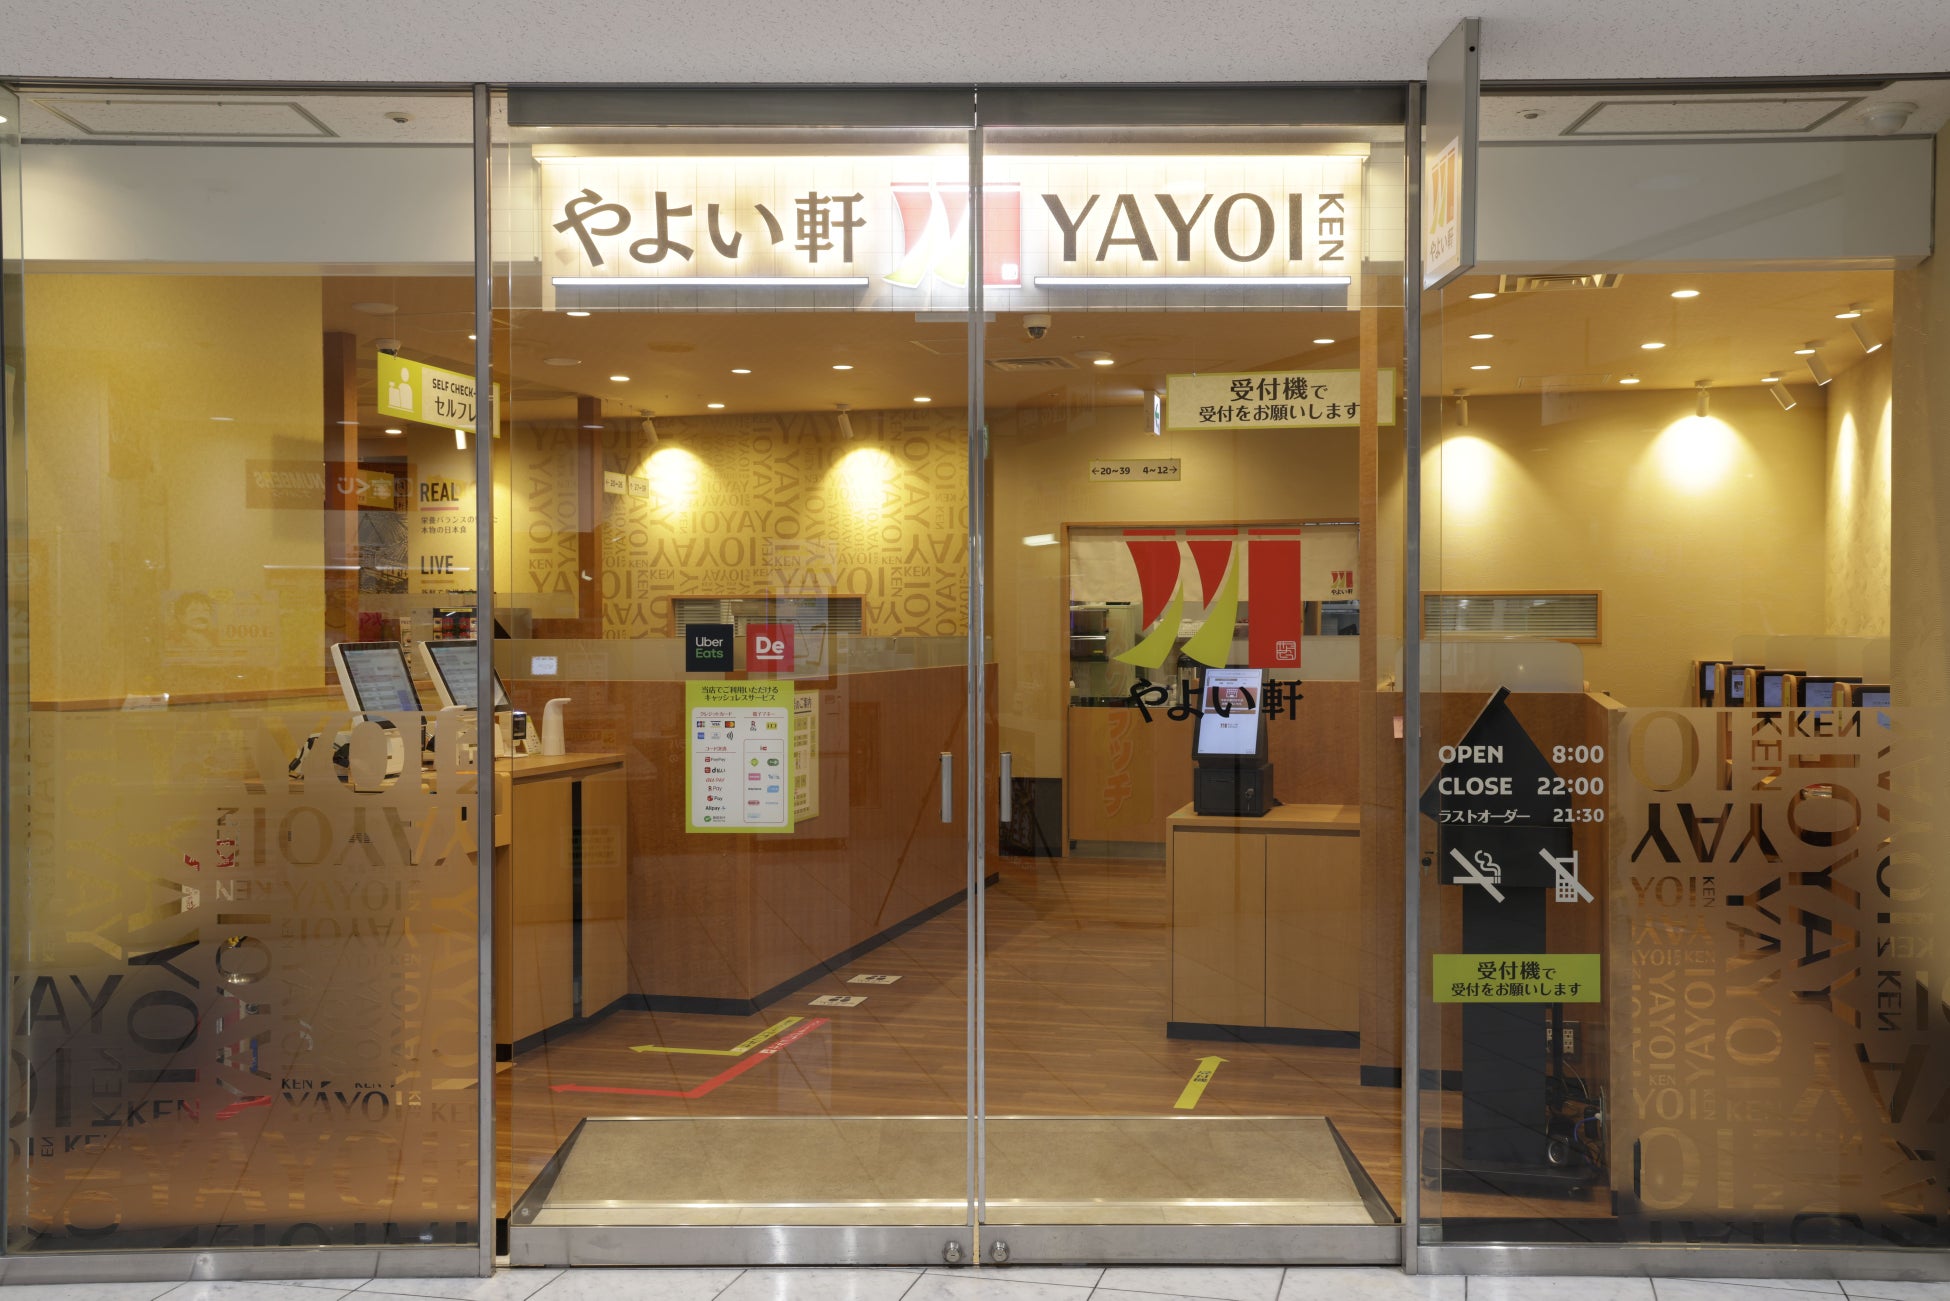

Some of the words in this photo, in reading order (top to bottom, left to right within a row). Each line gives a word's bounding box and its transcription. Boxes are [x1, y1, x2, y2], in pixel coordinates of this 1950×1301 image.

[553, 189, 867, 267] やよい軒
[1041, 192, 1303, 262] YAYOI
[1319, 193, 1344, 261] KEN
[432, 378, 450, 391] SELF
[1230, 376, 1329, 402] 受付機で
[1199, 402, 1361, 423] 受付をお願いします
[420, 481, 459, 502] REAL
[420, 554, 454, 575] LIVE
[695, 636, 724, 648] Uber
[755, 636, 785, 655] De
[695, 648, 724, 659] Eats
[701, 685, 780, 695] 当店でご利用いただける
[704, 694, 777, 702] キャッシュレスサービス
[1128, 678, 1304, 723] やよい軒
[1438, 745, 1503, 763] OPEN
[1552, 745, 1604, 763] 8:00
[1438, 777, 1513, 795] CLOSE
[1537, 777, 1604, 795] 22:00
[1438, 808, 1531, 824] ラストオーダー
[1553, 808, 1605, 823] 21:30
[1477, 961, 1556, 981] 受付機で
[1451, 981, 1582, 997] 受付をお願いします
